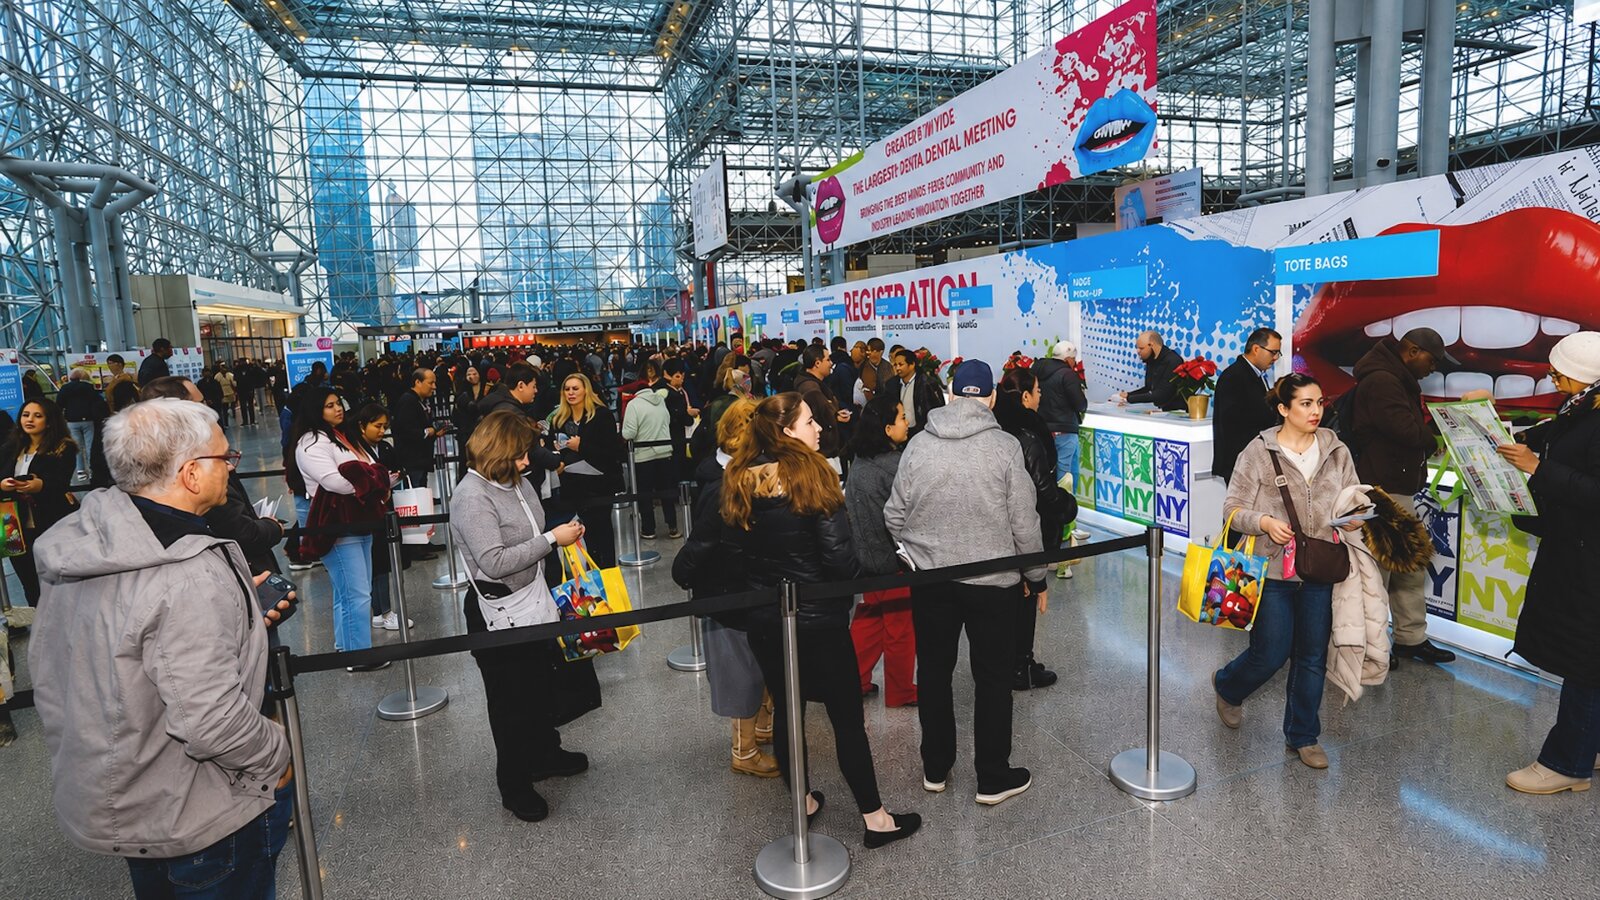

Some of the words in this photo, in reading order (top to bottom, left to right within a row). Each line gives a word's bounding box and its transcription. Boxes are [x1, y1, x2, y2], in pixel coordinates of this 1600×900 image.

[852, 180, 864, 196] THE
[925, 134, 961, 164] DENTAL
[963, 107, 1016, 148] MEETING
[945, 161, 986, 187] COMMUNITY
[987, 154, 1005, 172] AND
[950, 184, 985, 206] TOGETHER
[1284, 258, 1312, 272] TOTE
[1315, 255, 1348, 270] BAGS
[1096, 478, 1122, 504] NY
[1125, 485, 1153, 513] NY
[1156, 493, 1188, 522] NY
[1461, 571, 1527, 620] NY
